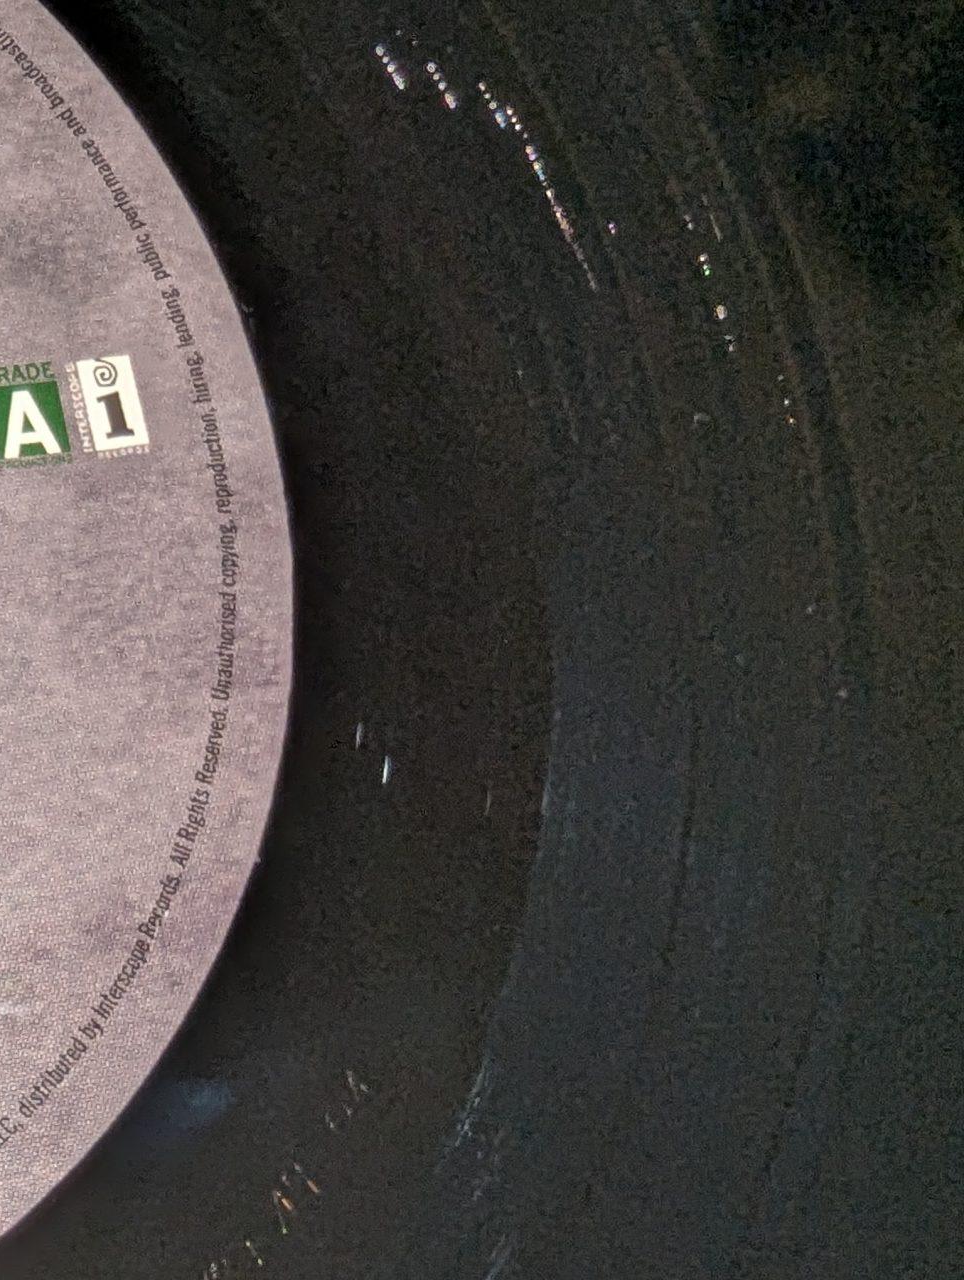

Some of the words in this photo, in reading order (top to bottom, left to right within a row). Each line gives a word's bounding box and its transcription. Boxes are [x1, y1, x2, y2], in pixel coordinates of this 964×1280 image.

[56, 106, 87, 137] and
[81, 138, 147, 235] performance
[136, 233, 171, 282] public
[4, 389, 62, 459] A
[201, 407, 235, 515] reproduction,
[219, 519, 240, 587] copying,
[210, 591, 237, 701] Unauthorised
[194, 707, 229, 786] Reserved.
[176, 788, 210, 844] Rights
[169, 842, 193, 869] All
[90, 937, 150, 1019] Interscope
[78, 1018, 105, 1041] by
[18, 1039, 87, 1118] distributed
